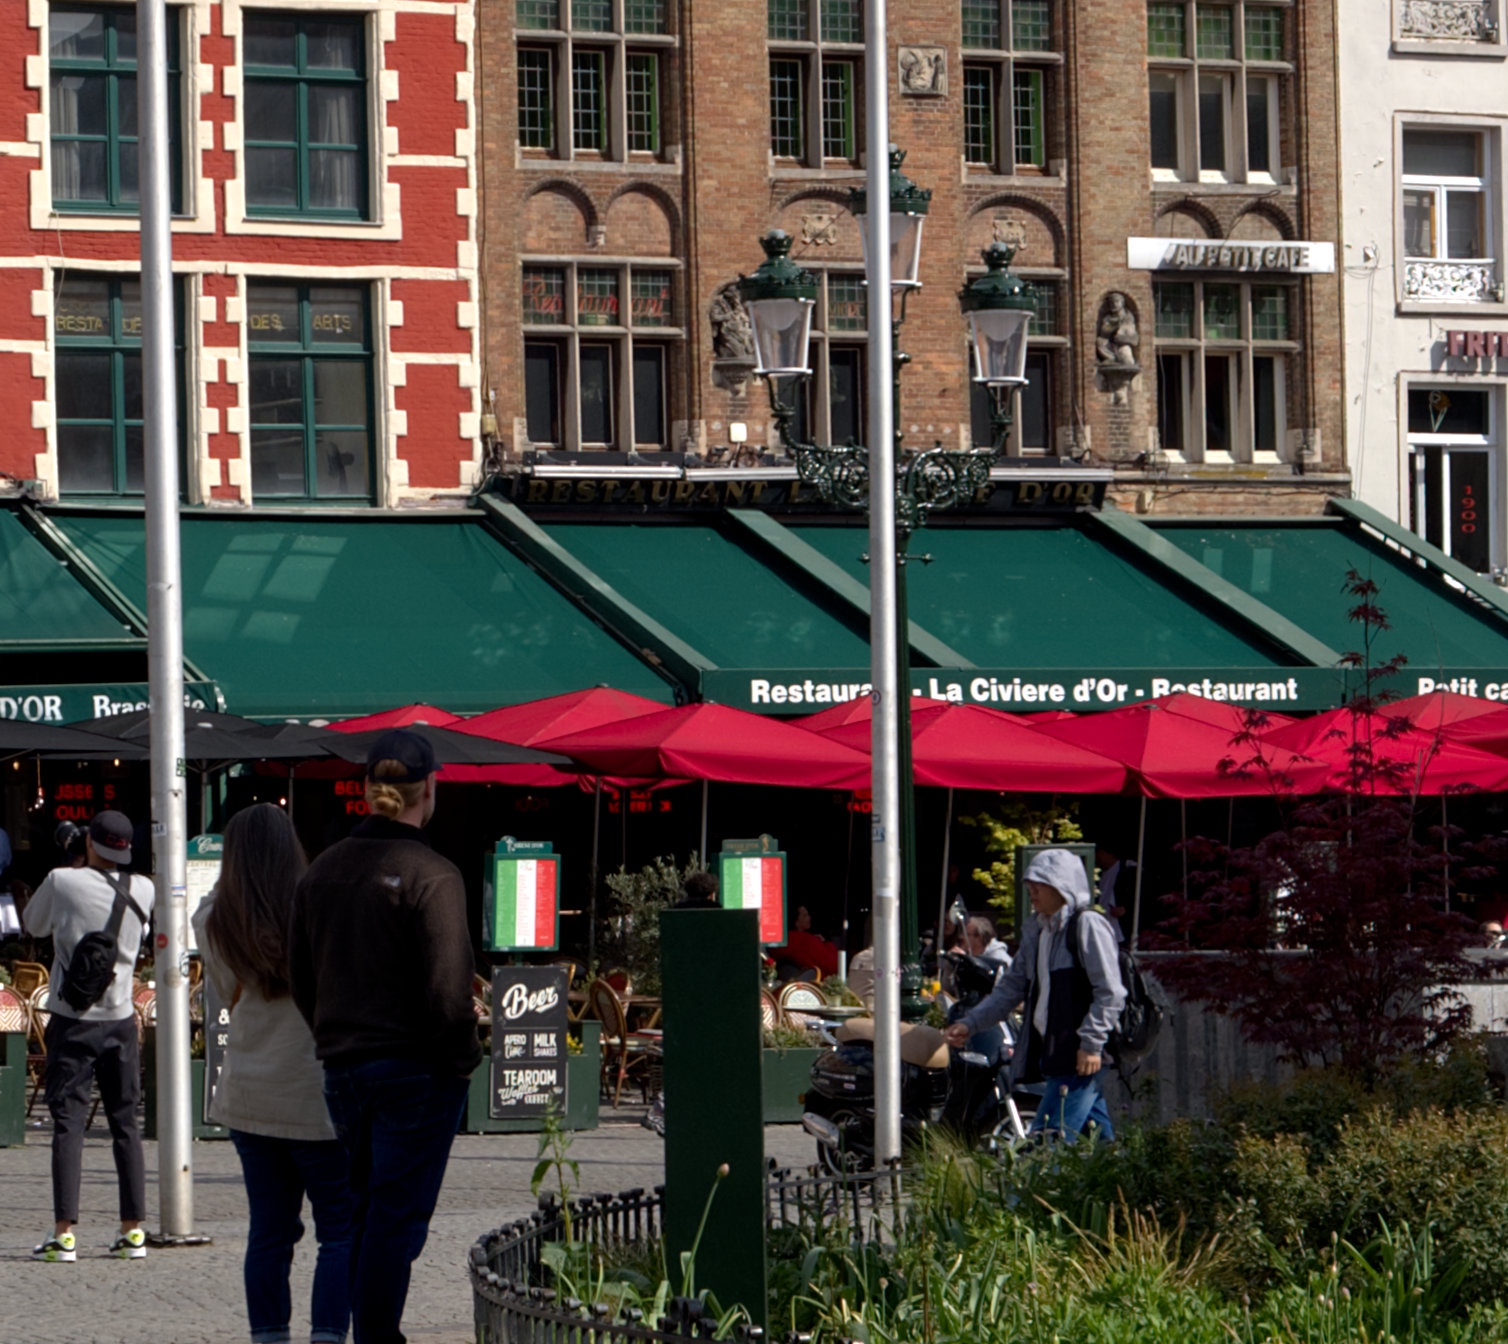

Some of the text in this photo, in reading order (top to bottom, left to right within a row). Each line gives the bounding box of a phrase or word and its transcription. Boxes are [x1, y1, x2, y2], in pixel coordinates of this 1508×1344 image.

[527, 479, 768, 505] RESTAURANT
[1461, 485, 1476, 534] 1900
[750, 678, 873, 704] Restaura
[928, 679, 962, 703] La
[970, 678, 1070, 703] Civiere
[1073, 677, 1129, 703] d'Or
[501, 983, 559, 1020] Beer
[533, 1032, 557, 1047] MILK
[503, 1069, 557, 1086] TEAROOM
